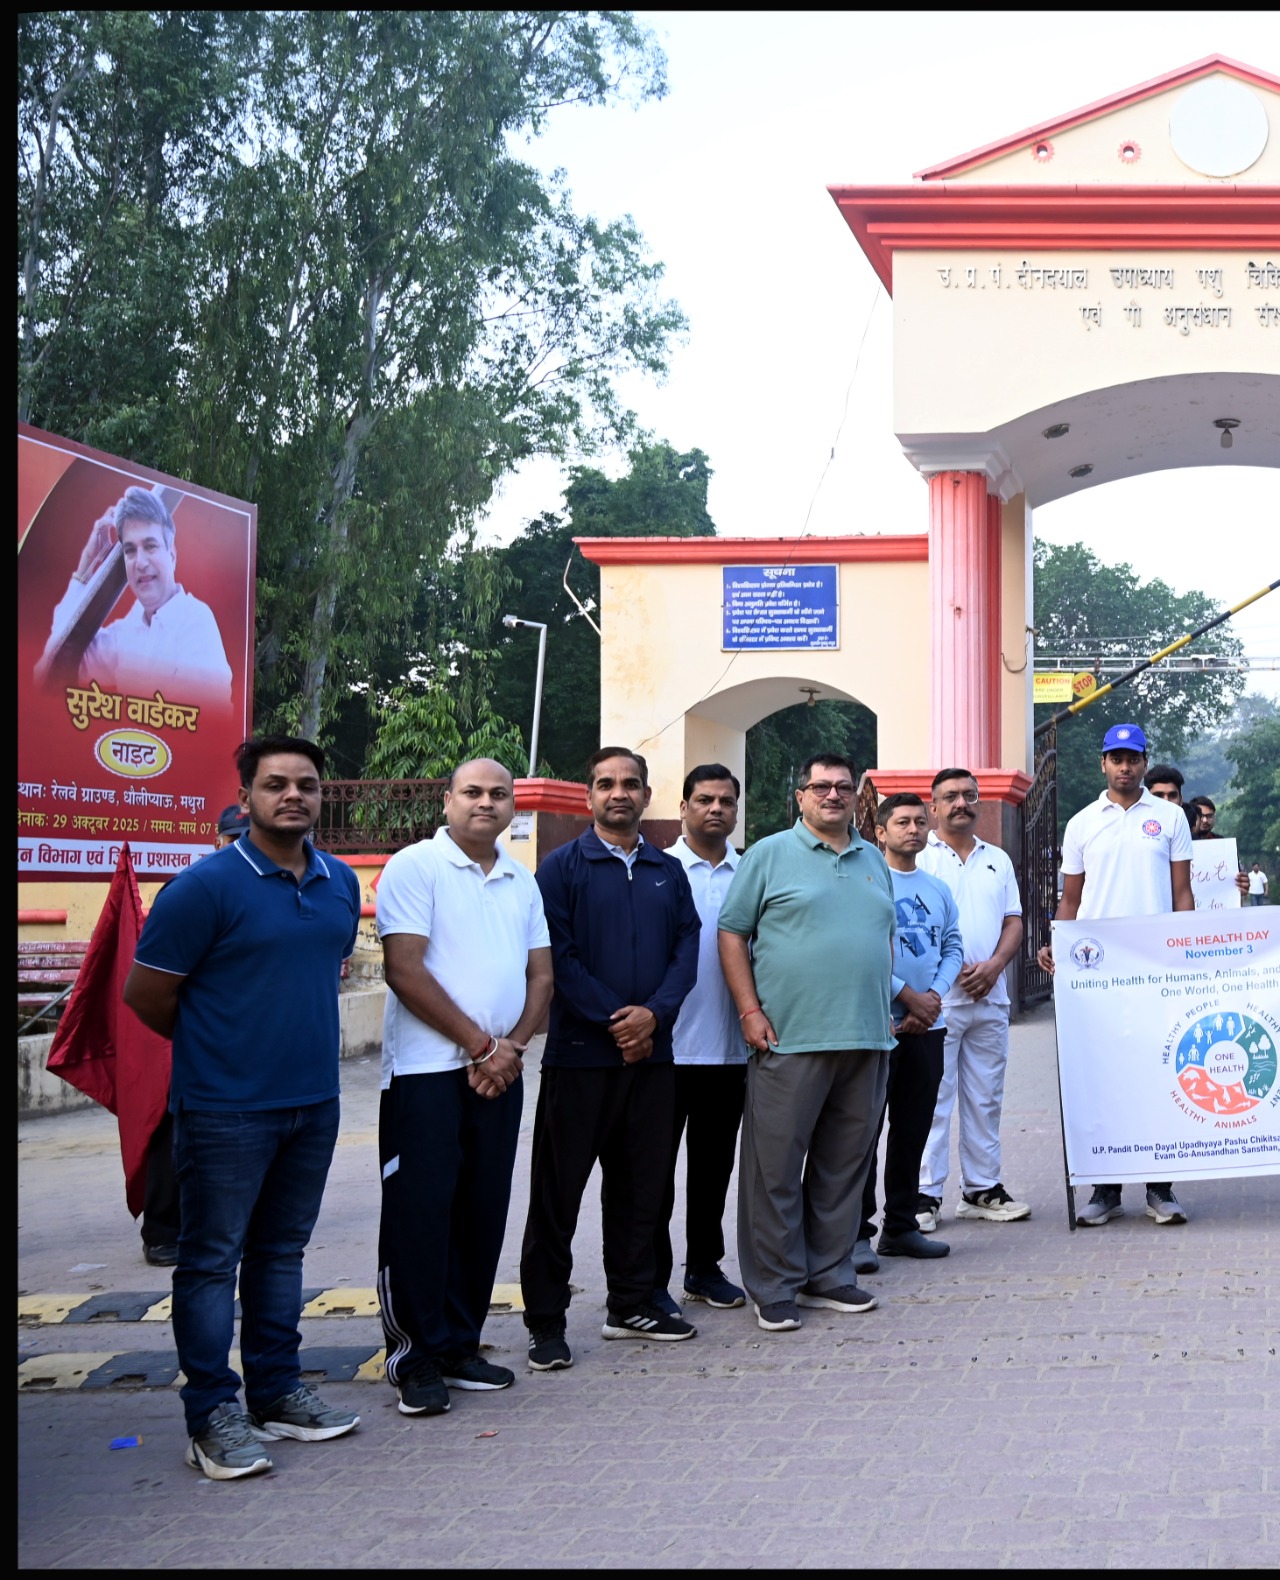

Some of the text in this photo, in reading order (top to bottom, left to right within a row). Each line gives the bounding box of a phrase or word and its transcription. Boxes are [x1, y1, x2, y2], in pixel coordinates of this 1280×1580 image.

[1109, 266, 1174, 289] उपाध्याय
[1195, 267, 1223, 298] पशु
[1079, 301, 1103, 331] एवं
[1163, 302, 1232, 336] अनुसंधान
[763, 568, 796, 580] सूचना
[1073, 675, 1093, 693] STOP
[66, 681, 199, 731] सुरेश वाडेकर
[111, 741, 157, 768] नाइट
[51, 779, 77, 801] रेलवे
[180, 795, 205, 814] मथुरा
[53, 813, 67, 828] 29
[71, 814, 110, 834] अक्टूबर
[113, 817, 139, 832] 2025
[179, 817, 197, 835] सायं
[200, 822, 212, 835] 07
[38, 844, 82, 865] विभाग
[86, 846, 105, 865] एवं
[147, 852, 192, 868] प्रशासन
[1166, 930, 1270, 948] ONE HEALTH DAY
[1185, 945, 1254, 960] November 3
[1071, 979, 1109, 990] Uniting
[1111, 975, 1145, 988] Health
[1148, 974, 1163, 984] for
[1165, 971, 1212, 983] Humans,
[1214, 967, 1260, 979] Animals,
[1160, 987, 1182, 998] One
[1185, 984, 1219, 997] World,
[1221, 982, 1243, 993] One
[1162, 999, 1220, 1065] HEALTHY PEOPLE
[1214, 1052, 1235, 1062] ONE
[1209, 1064, 1245, 1074] HEALTH
[1170, 1090, 1258, 1129] HEALTHY ANIMALS
[1092, 1146, 1107, 1155] U.P.
[1108, 1145, 1132, 1154] Pandit
[1155, 1142, 1178, 1152] Dayal
[1179, 1138, 1223, 1150] Upadhyaya
[1224, 1136, 1248, 1146] Pashu
[1154, 1151, 1176, 1160] Evam
[1177, 1147, 1240, 1159] Go-Anusandhan
[1241, 1144, 1280, 1154] Sansthan,
